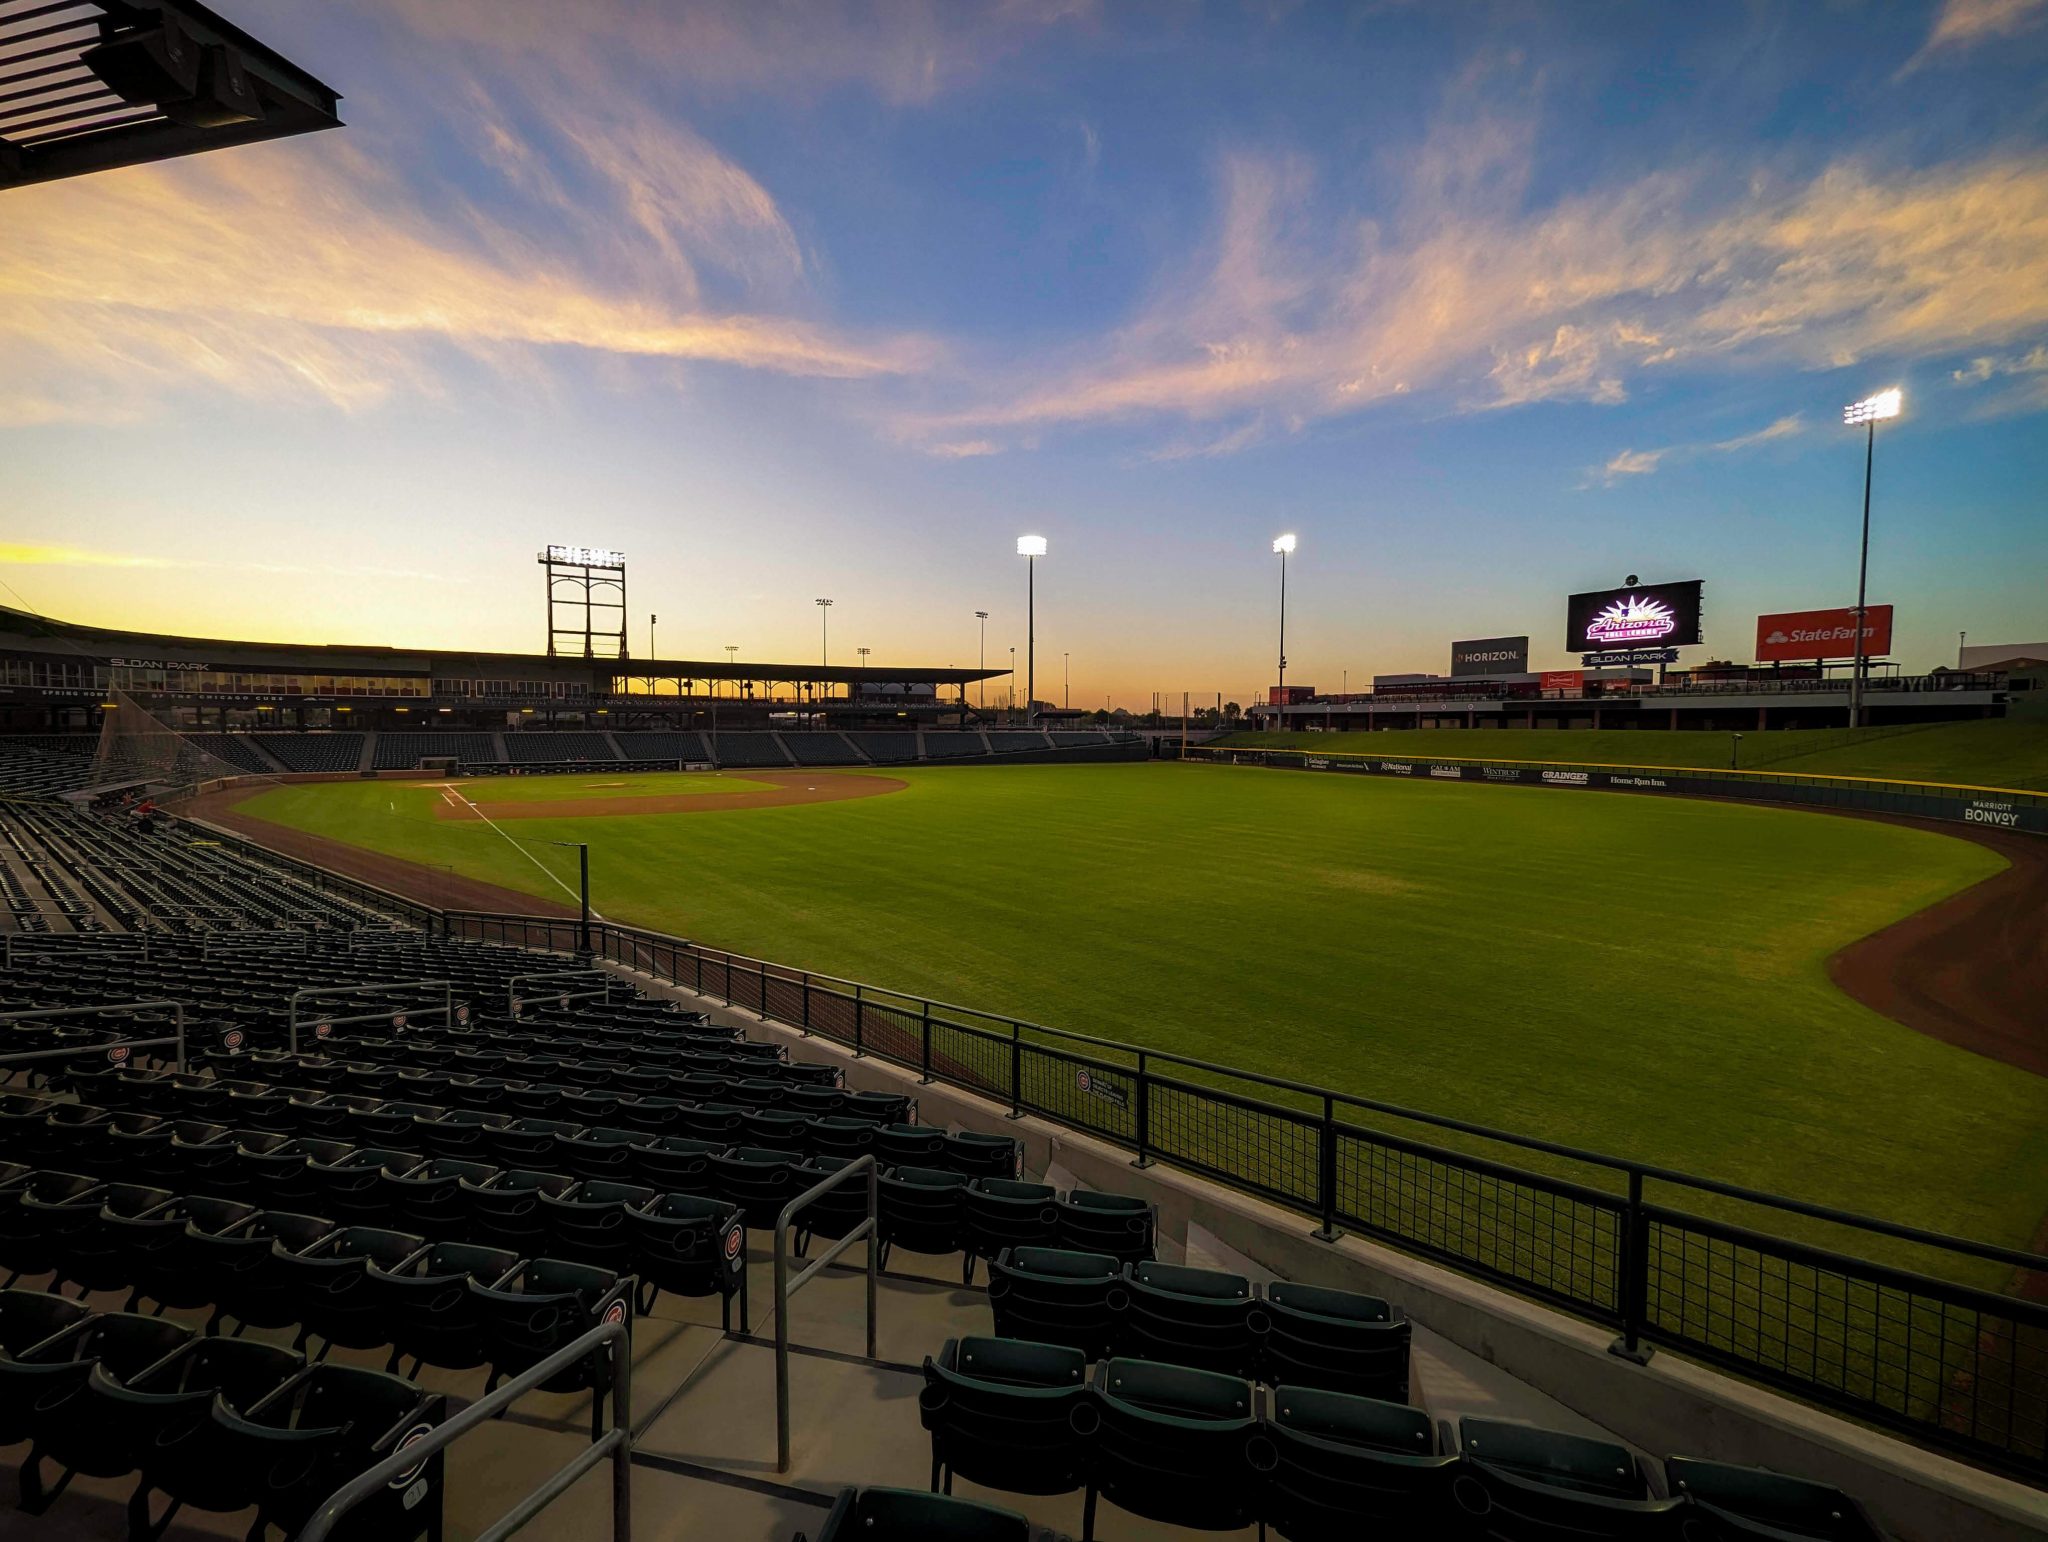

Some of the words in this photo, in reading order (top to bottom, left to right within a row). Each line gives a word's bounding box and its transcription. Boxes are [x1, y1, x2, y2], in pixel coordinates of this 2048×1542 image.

[1590, 617, 1668, 632] Arizona
[1790, 629, 1831, 642] State
[1590, 655, 1631, 664] SLOAN
[1633, 652, 1667, 662] PARK
[110, 658, 163, 669] SLOAN
[166, 661, 209, 671] PARK
[1388, 762, 1413, 771] National
[1542, 771, 1589, 780] GRAINGER
[1610, 776, 1634, 785] Home
[1634, 777, 1651, 787] Run
[1973, 801, 2012, 811] MARRIOTT
[1965, 808, 2019, 826] BONVOY
